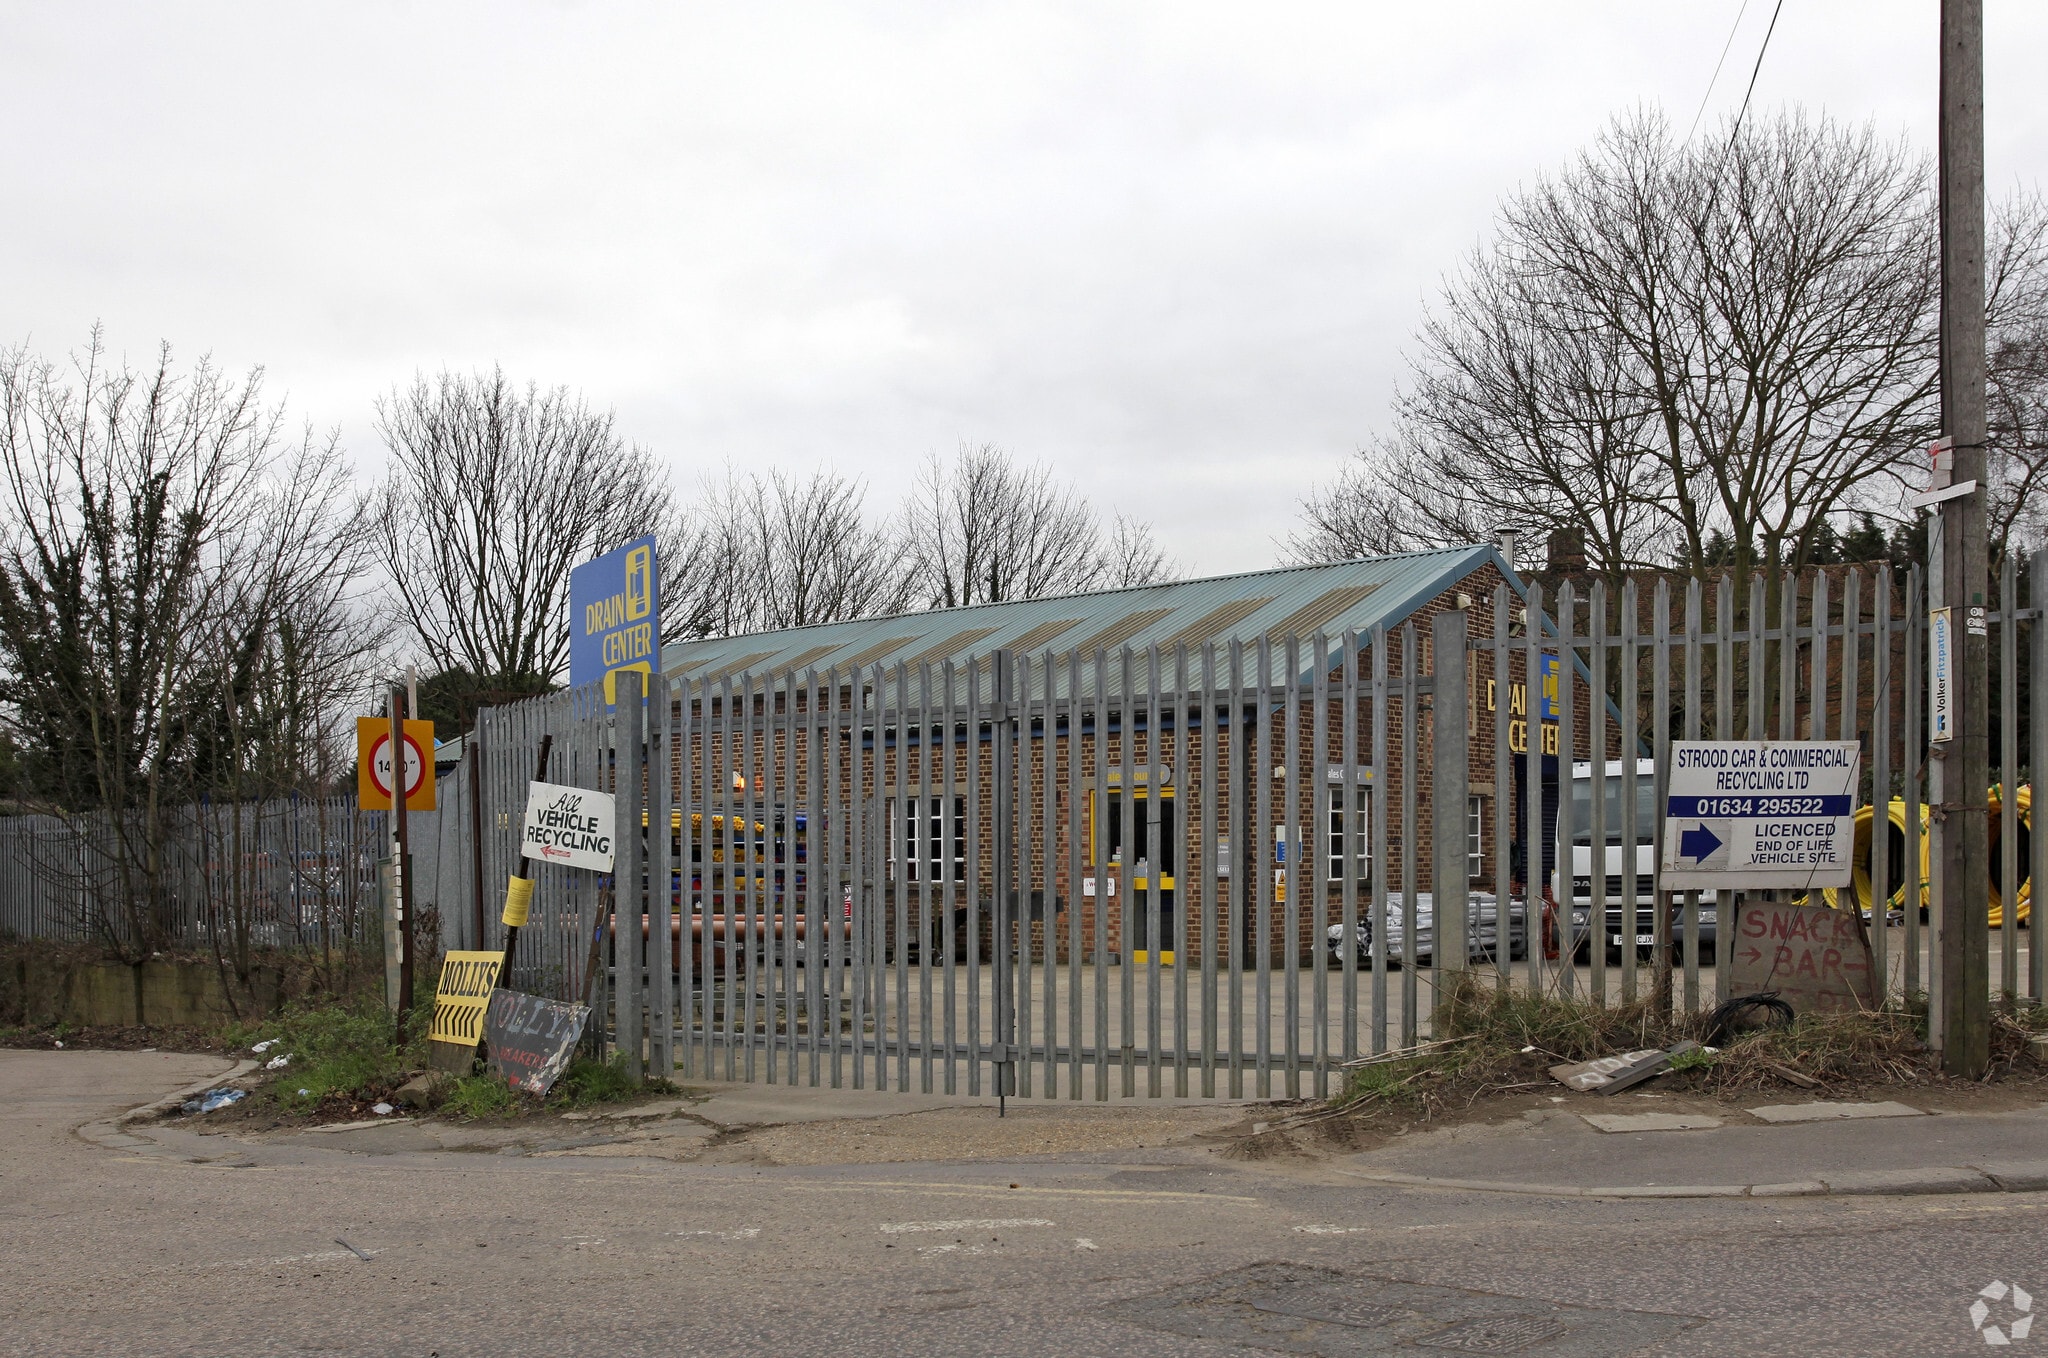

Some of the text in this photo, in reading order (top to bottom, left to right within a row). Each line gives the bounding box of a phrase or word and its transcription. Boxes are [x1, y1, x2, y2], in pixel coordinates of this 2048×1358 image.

[586, 593, 625, 636] DRAIN
[603, 622, 652, 667] CENTER
[1936, 618, 1947, 713] VolkerFitzpatrick
[1678, 748, 1849, 768] STROOD CAR & COMMERCIAL
[1716, 771, 1809, 790] RECYCLING LTD
[548, 793, 582, 813] All
[1697, 798, 1824, 815] 01634 295522
[537, 809, 599, 834] VEHICLE
[1755, 823, 1836, 837] LICENCED
[526, 826, 610, 854] RECYCLING
[1755, 840, 1833, 852] END OF LIFE
[1751, 852, 1836, 864] VEHICLE SITE
[1741, 909, 1854, 944] SNACK
[1774, 945, 1844, 980] BAR
[438, 960, 499, 999] MOLLYS
